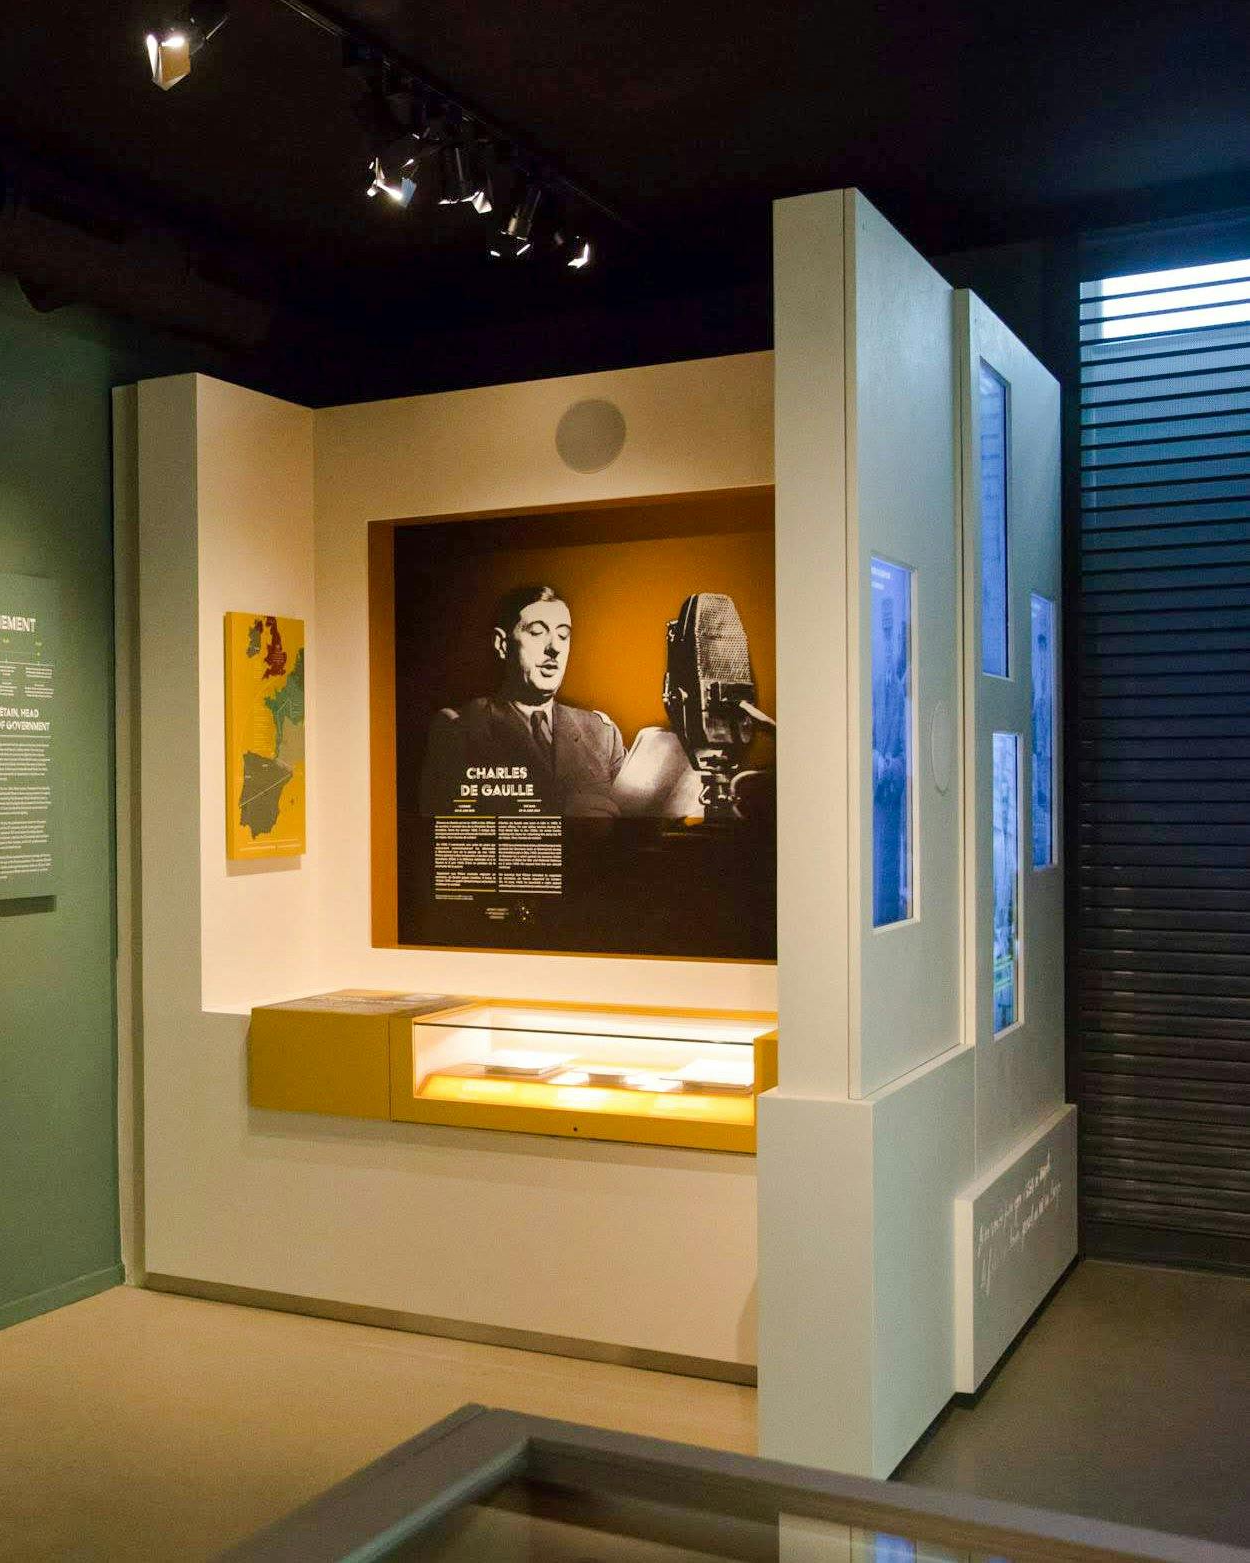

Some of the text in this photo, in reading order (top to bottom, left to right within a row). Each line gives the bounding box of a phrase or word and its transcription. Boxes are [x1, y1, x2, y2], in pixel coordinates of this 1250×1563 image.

[20, 707, 39, 718] HEAD
[6, 720, 50, 731] GOVERNMENT
[466, 766, 528, 780] CHARLES
[461, 784, 534, 796] DE GAULLE
